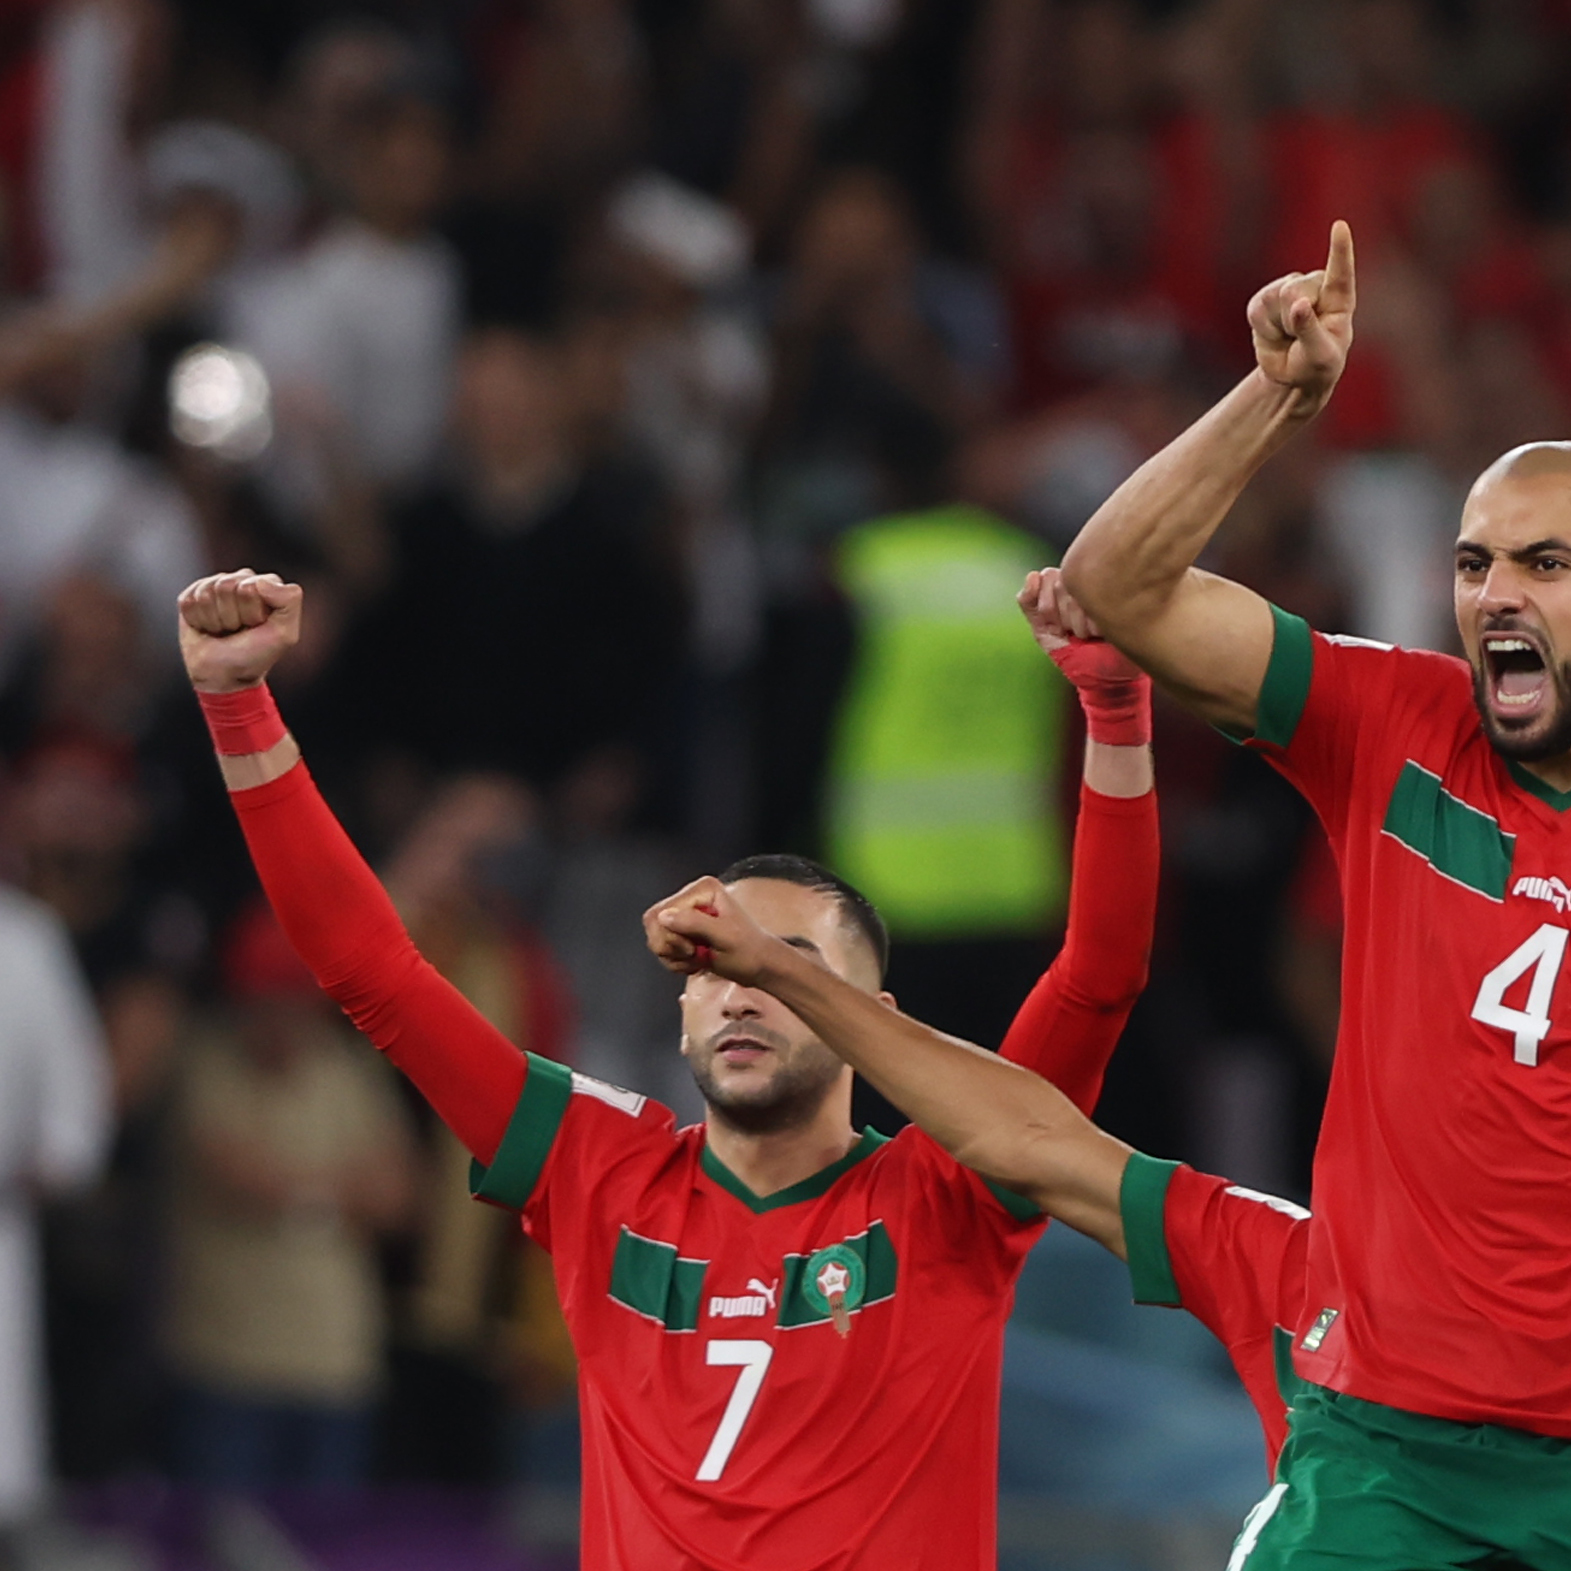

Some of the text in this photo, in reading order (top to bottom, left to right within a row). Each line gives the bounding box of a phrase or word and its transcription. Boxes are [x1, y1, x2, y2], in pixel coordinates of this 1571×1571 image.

[1471, 923, 1568, 1066] 4
[708, 1296, 766, 1318] PUMA
[695, 1339, 774, 1481] 7
